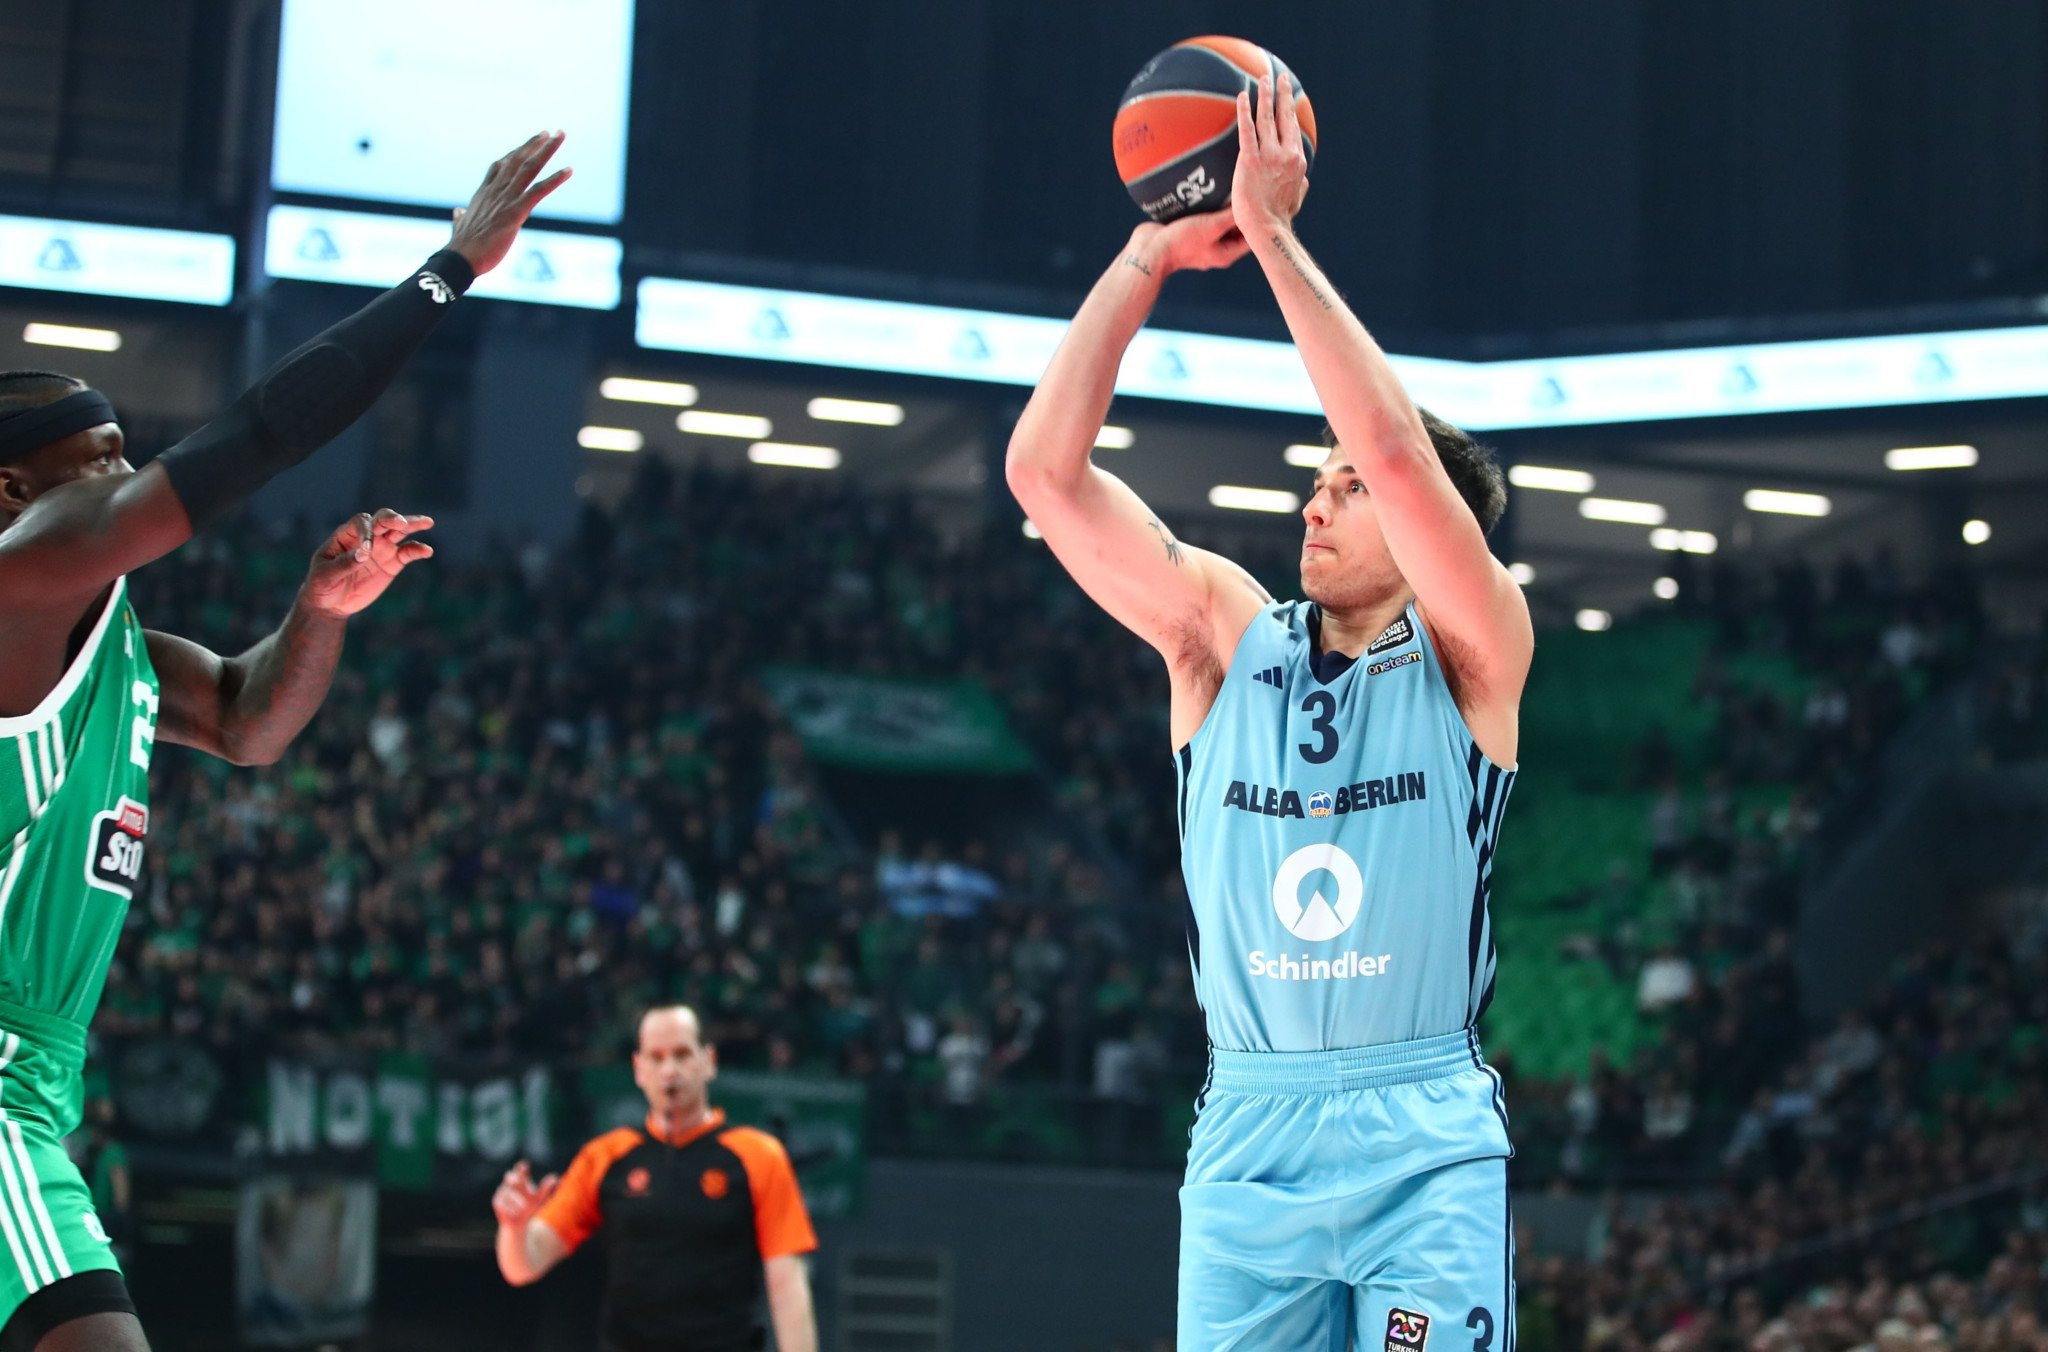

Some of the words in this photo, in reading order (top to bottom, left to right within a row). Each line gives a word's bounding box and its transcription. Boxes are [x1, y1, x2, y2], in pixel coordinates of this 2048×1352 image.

[1367, 651, 1422, 675] oneteam
[1298, 690, 1340, 764] 3
[1222, 780, 1305, 819] ALBA
[1334, 771, 1426, 815] BERLIN
[1248, 950, 1391, 981] Schindler
[1389, 1312, 1425, 1343] 25
[1466, 1306, 1494, 1352] 3
